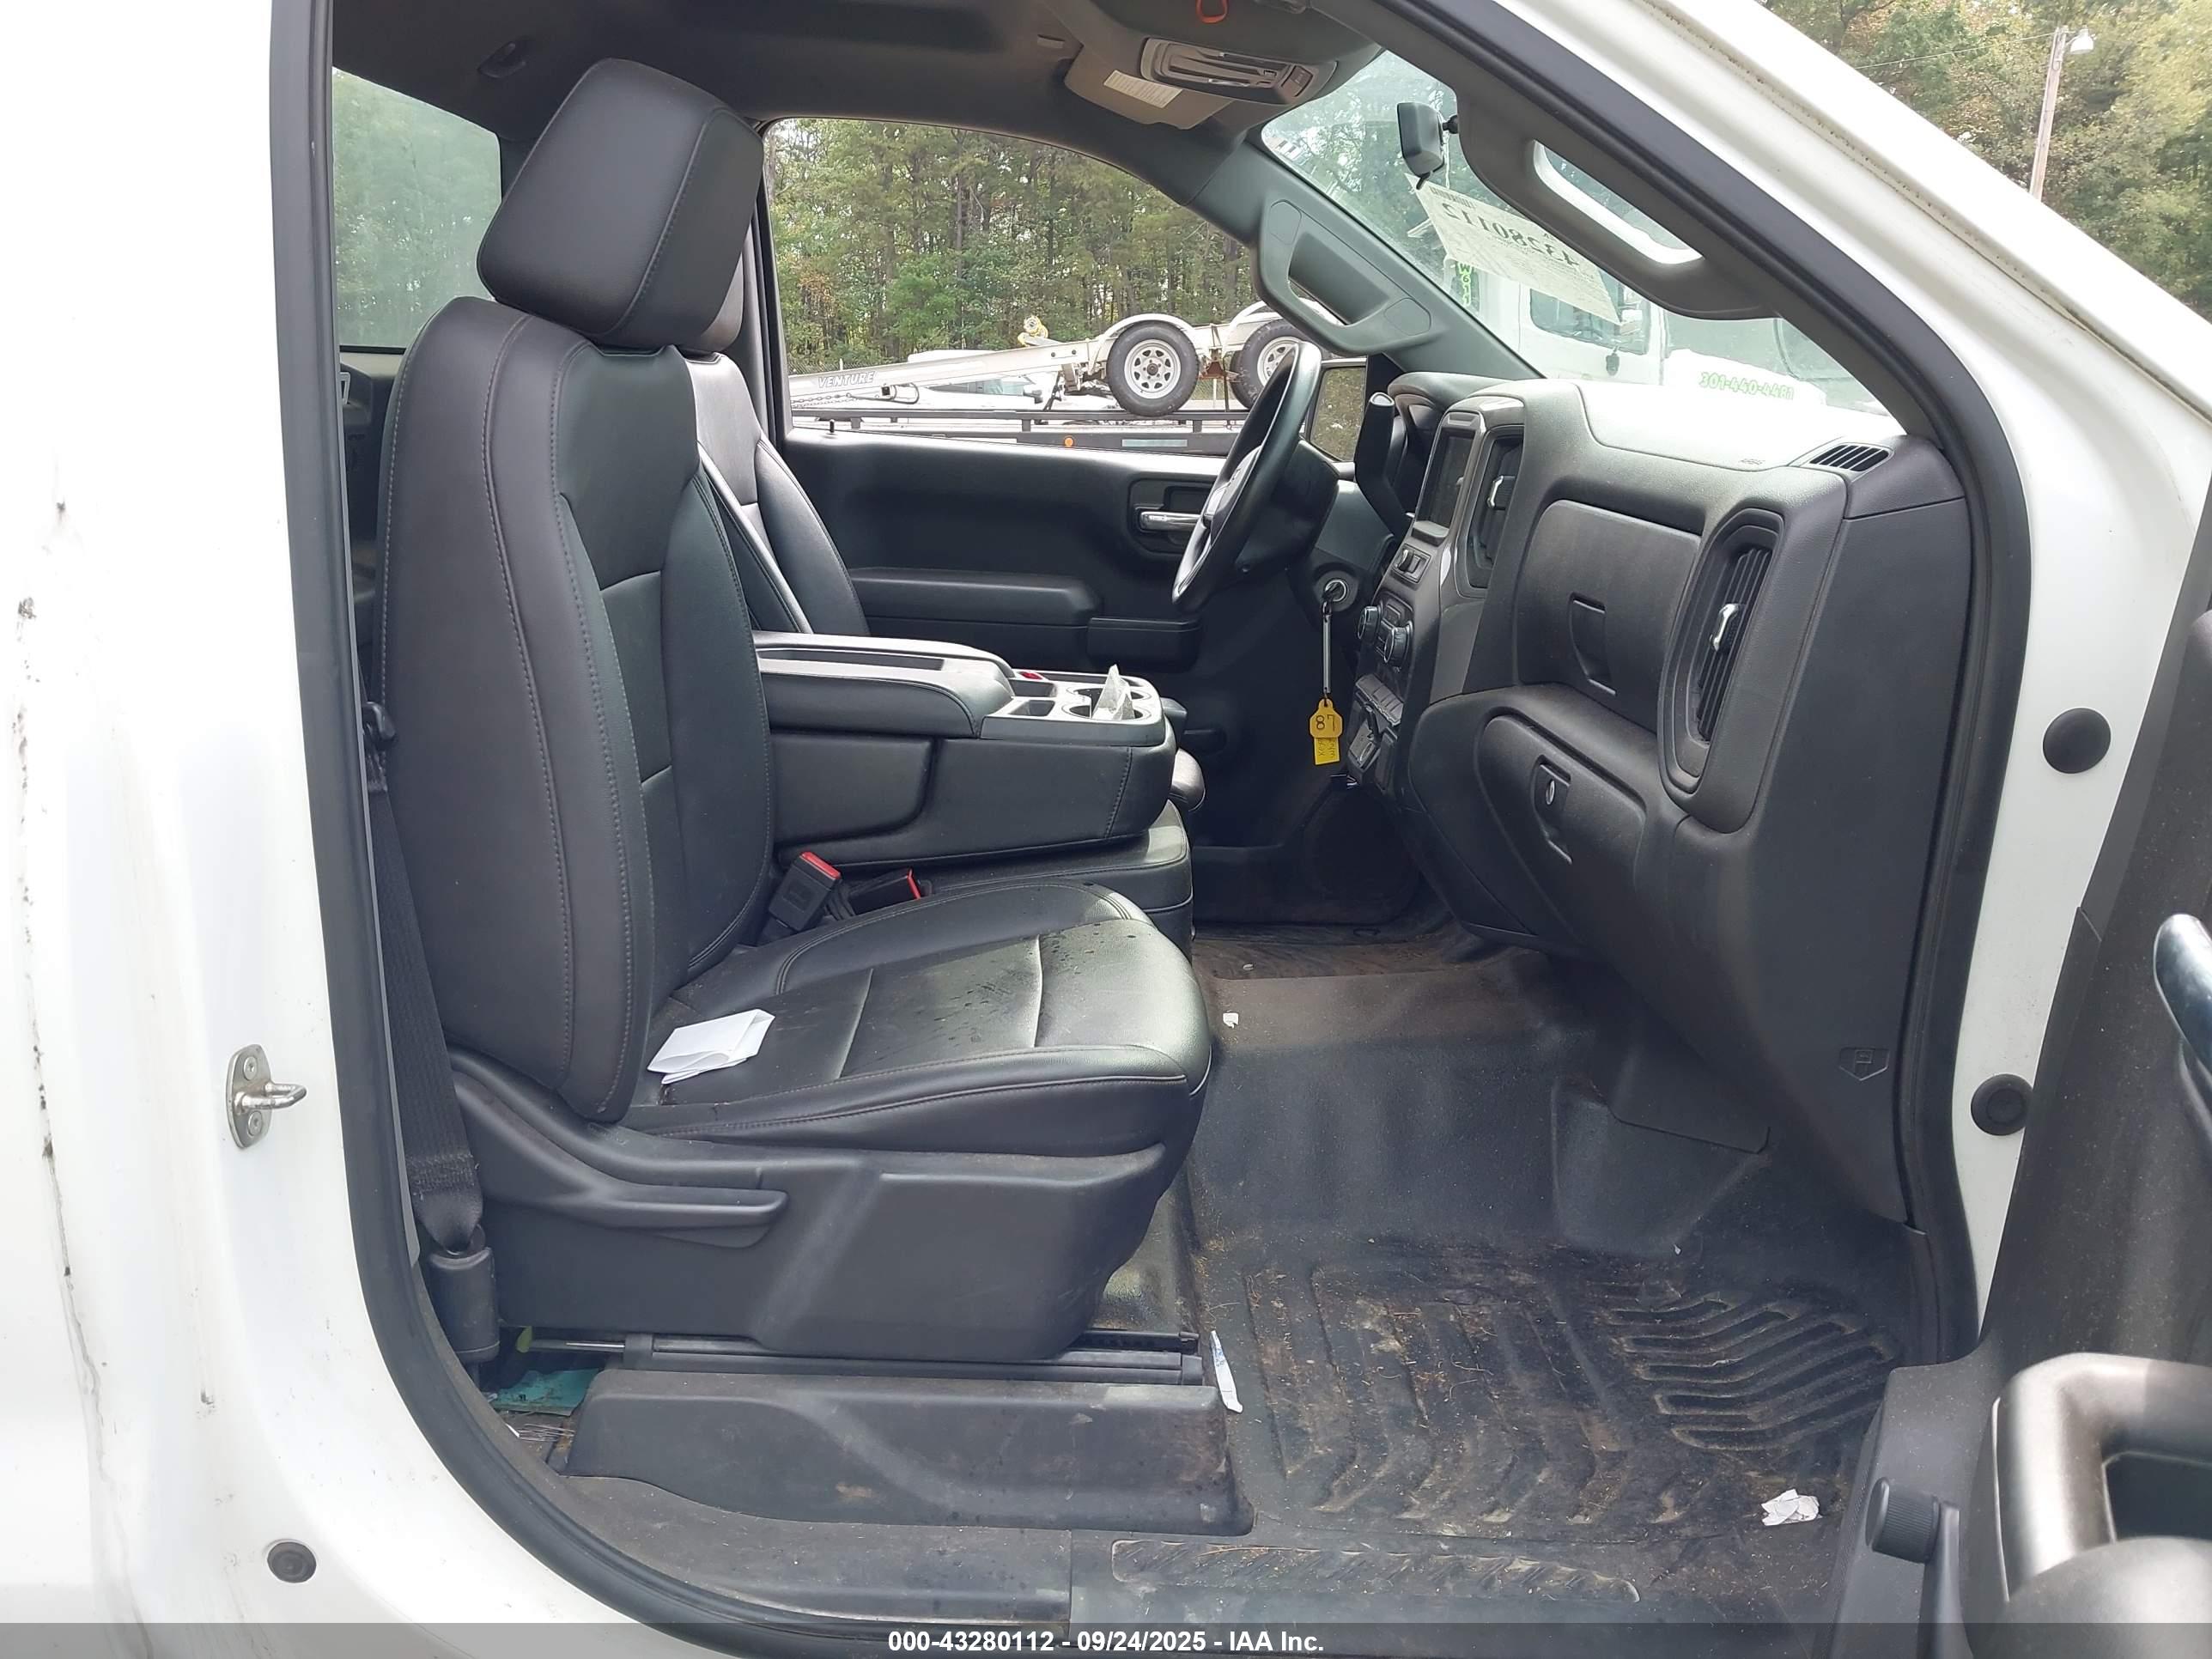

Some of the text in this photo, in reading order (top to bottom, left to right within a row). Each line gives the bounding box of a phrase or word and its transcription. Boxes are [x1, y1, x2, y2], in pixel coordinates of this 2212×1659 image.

[817, 370, 877, 389] VENTURE
[1699, 371, 1795, 401] 301-440-4481
[1316, 714, 1336, 732] 87
